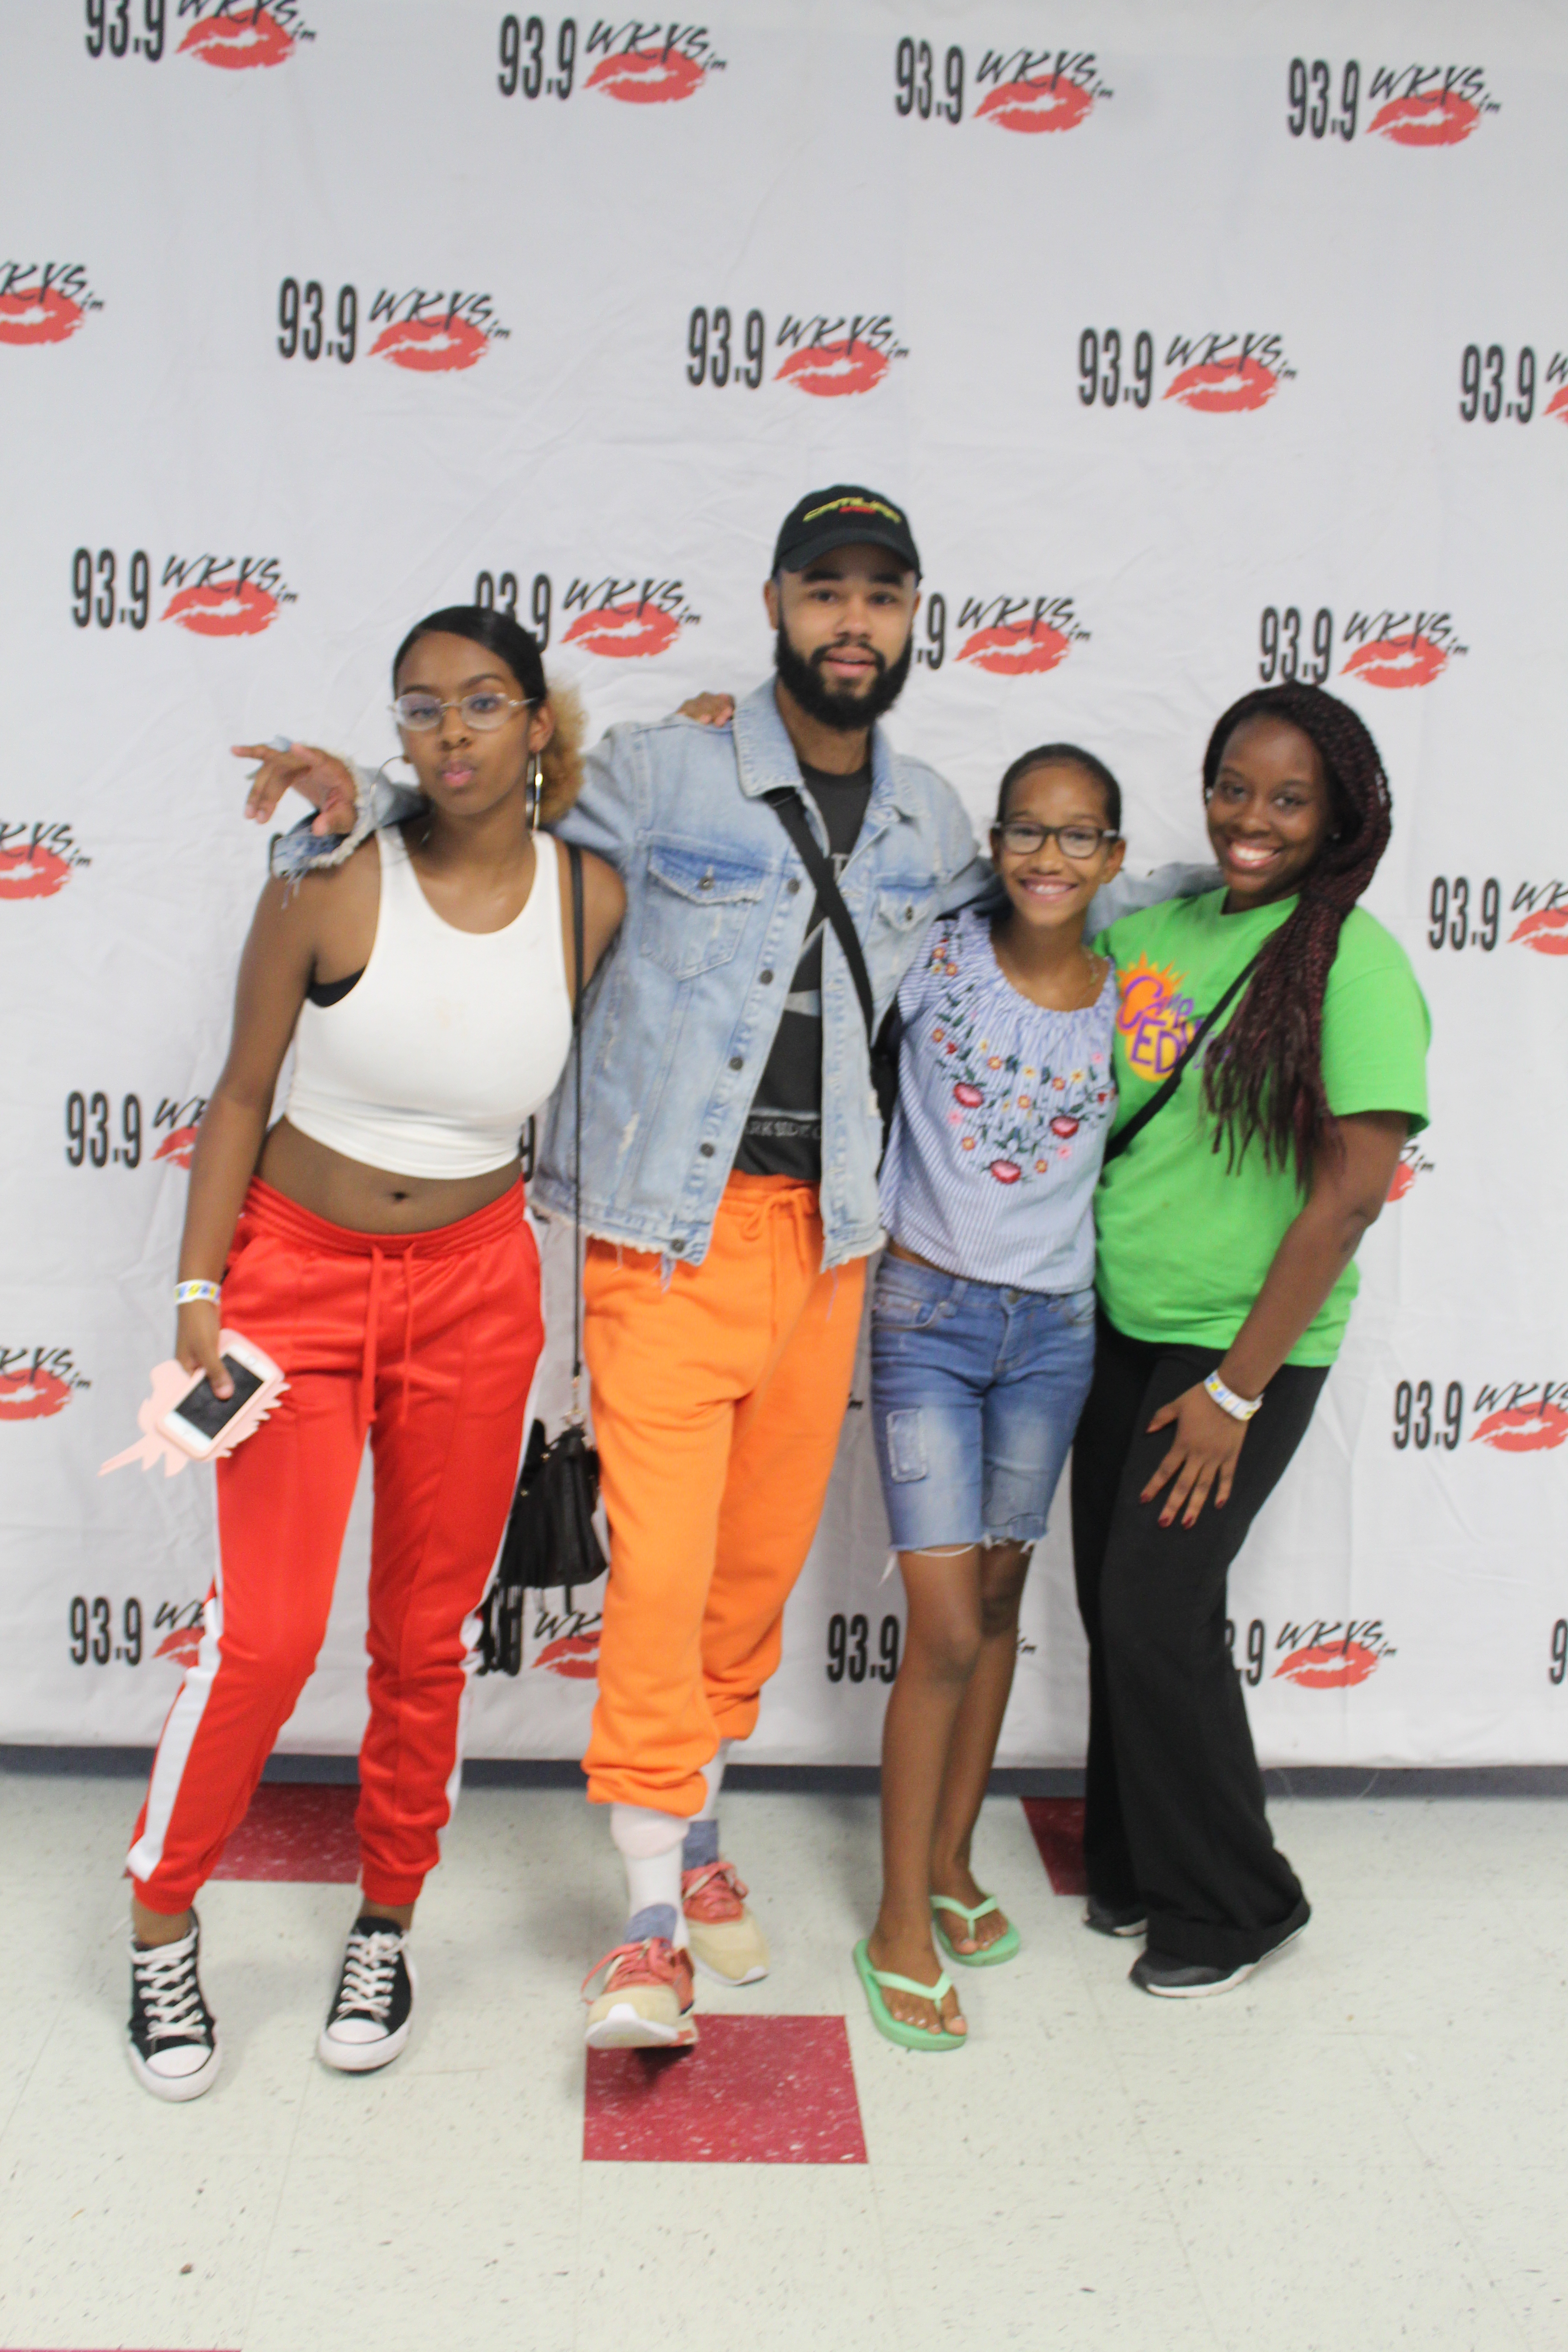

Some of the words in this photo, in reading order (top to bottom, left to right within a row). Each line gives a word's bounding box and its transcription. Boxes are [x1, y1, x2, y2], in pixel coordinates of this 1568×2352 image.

[84, 0, 167, 63] 93.9
[497, 13, 577, 100] 93.9
[584, 19, 710, 64] WKYS
[895, 36, 965, 125] 93.9
[975, 49, 1097, 91] WKYS
[1287, 57, 1361, 142] 93.9
[1368, 65, 1485, 106] WKYS
[0, 260, 88, 304] KYS
[277, 276, 358, 364] 93.9
[368, 289, 493, 330] WKYS
[687, 306, 765, 389] 93.9
[776, 314, 894, 355] WKYS
[1079, 327, 1154, 409] 93.9
[1165, 333, 1282, 372] WKYS
[1460, 343, 1536, 424] 93.9
[72, 547, 150, 630] 93.9
[161, 554, 280, 594] WKYS
[562, 577, 684, 617] WKYS
[957, 595, 1075, 635] WKYS
[1259, 605, 1334, 684] 93.9
[1343, 609, 1453, 650] WKYS
[0, 821, 74, 860] KYS
[1429, 876, 1501, 952] 93.9
[66, 1091, 142, 1170] 93.9
[0, 1346, 74, 1384] KYS
[1393, 1381, 1464, 1451] 93.9
[69, 1596, 142, 1667] 93.9
[826, 1612, 900, 1683] 93.9
[1275, 1618, 1385, 1655] WKYS
